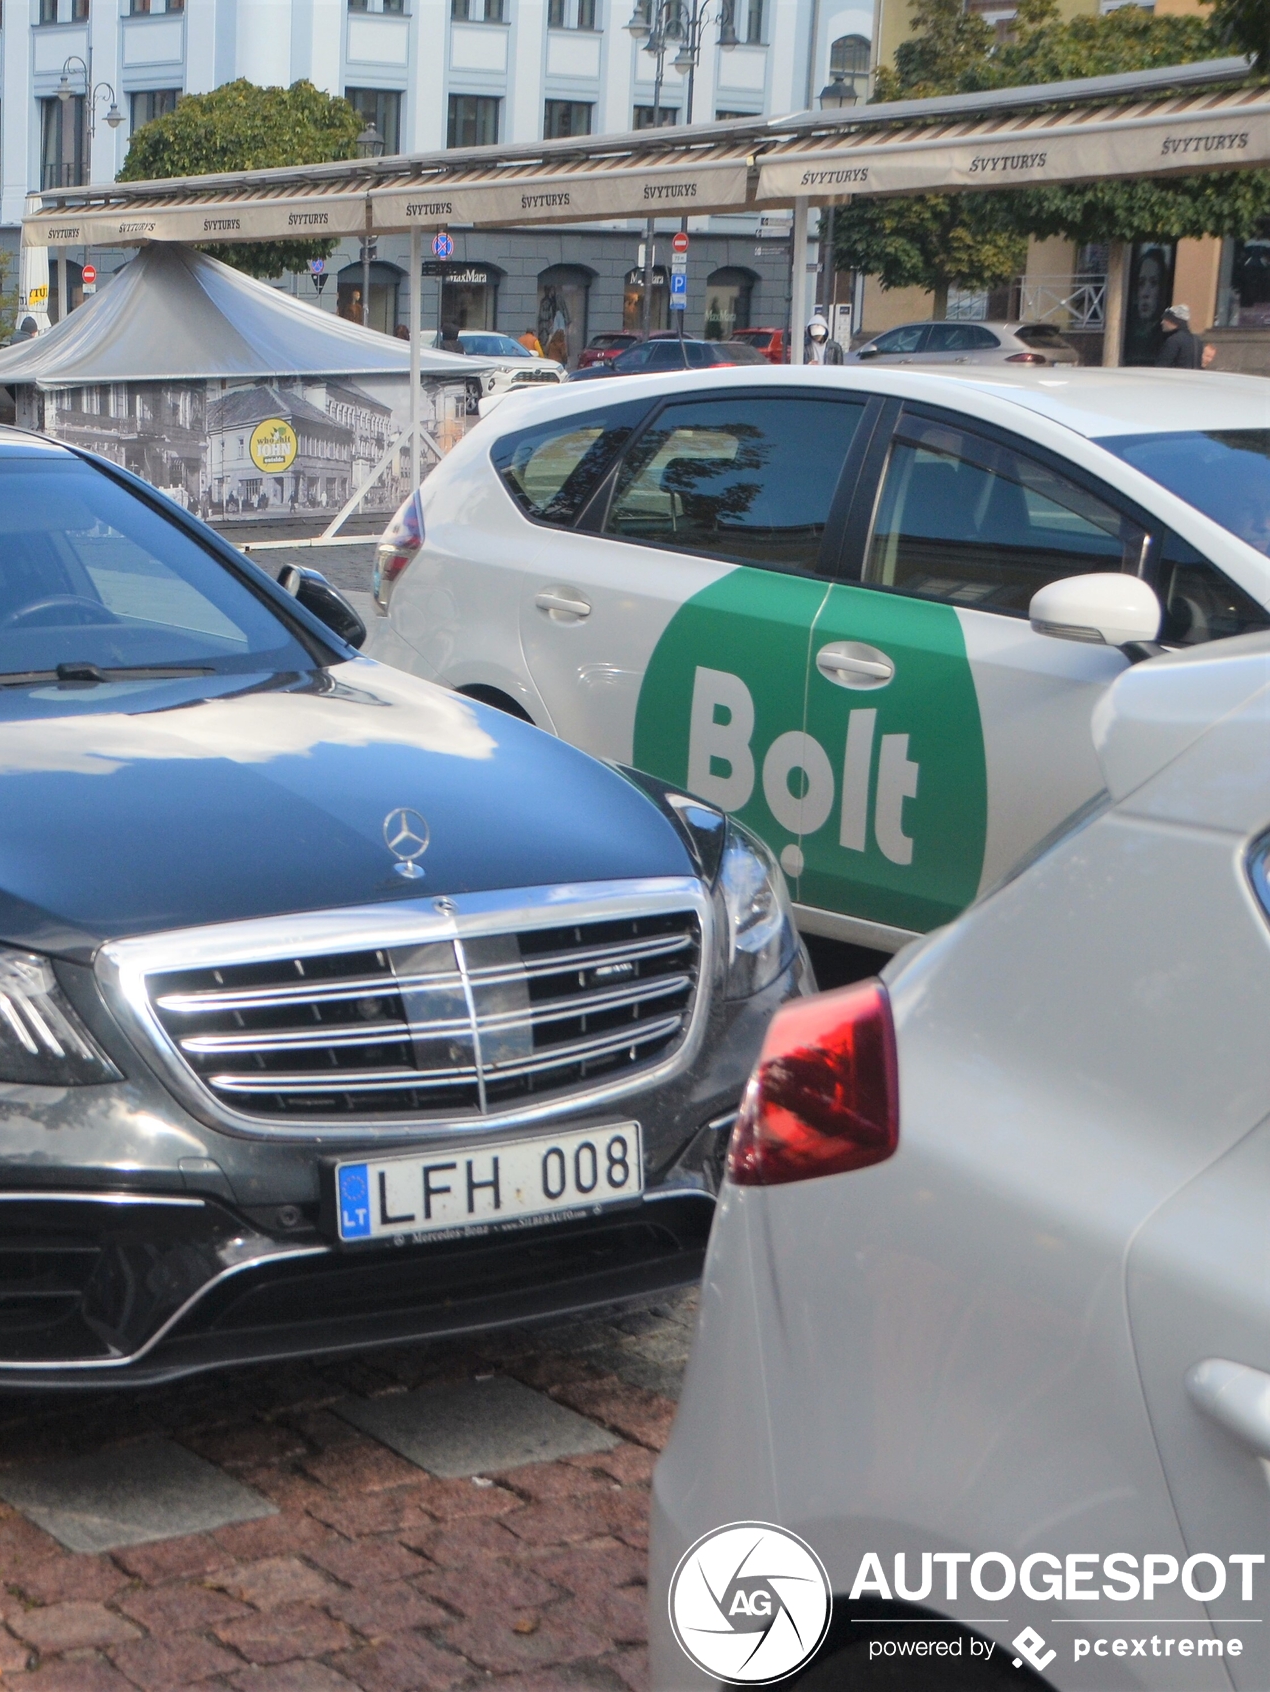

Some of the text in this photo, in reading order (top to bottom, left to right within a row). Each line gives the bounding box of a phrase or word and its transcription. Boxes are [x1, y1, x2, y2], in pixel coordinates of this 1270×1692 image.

[1160, 132, 1249, 156] ŠVYTURYS
[968, 152, 1048, 173] ŠVYTURYS
[800, 167, 869, 186] ŠVYTURYS
[643, 183, 698, 200] ŠVYTURYS
[405, 202, 453, 217] ŠVYTURYS
[520, 193, 571, 209] ŠVYTURYS
[203, 218, 241, 231] ŠVYTURYS
[287, 212, 330, 226] ŠVYTURYS
[47, 227, 81, 240] ŠVYTURYS
[118, 222, 157, 234] ŠVYTURYS
[674, 276, 684, 293] P
[256, 436, 275, 445] who
[256, 443, 292, 457] JOHN
[686, 664, 920, 878] Bolt
[377, 1134, 630, 1226] LFH 008
[342, 1207, 368, 1228] LT
[411, 1225, 489, 1244] Mercedes-Benz
